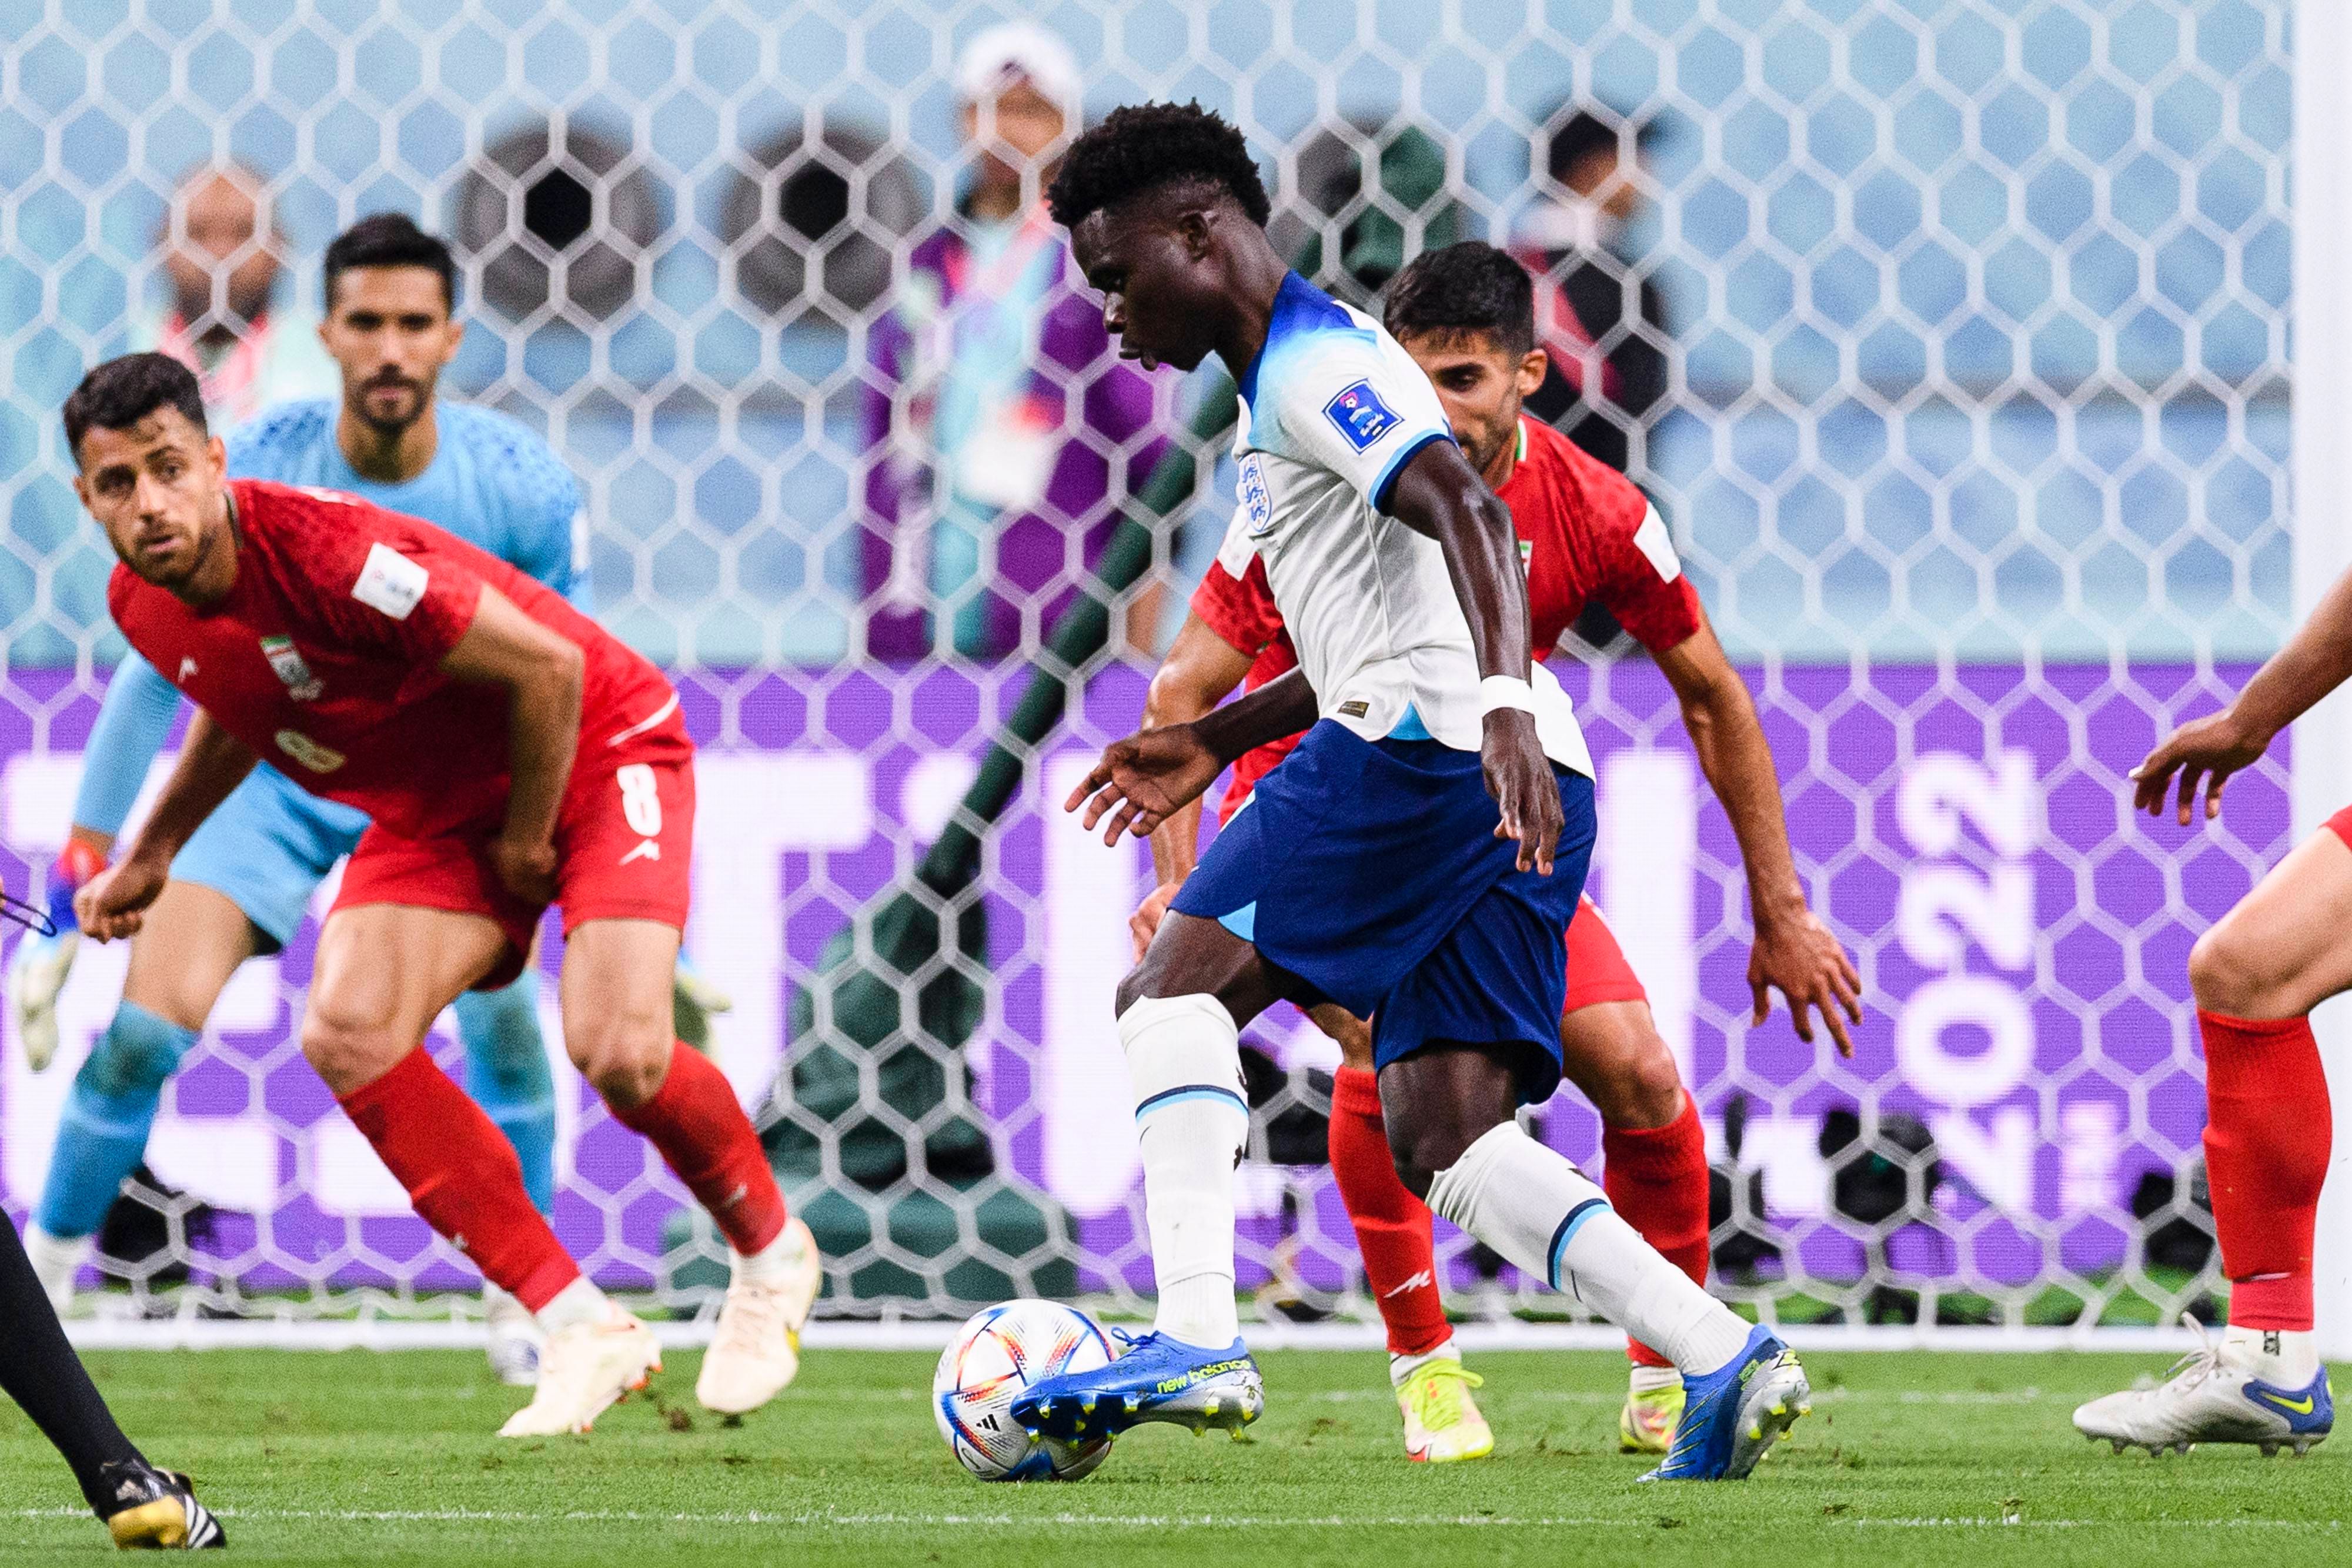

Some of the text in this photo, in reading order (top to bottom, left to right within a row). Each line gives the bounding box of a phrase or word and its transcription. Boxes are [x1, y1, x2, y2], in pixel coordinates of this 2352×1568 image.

[616, 763, 662, 837] 8
[1896, 745, 2036, 1213] 2022
[1157, 1359, 1252, 1394] new balance
